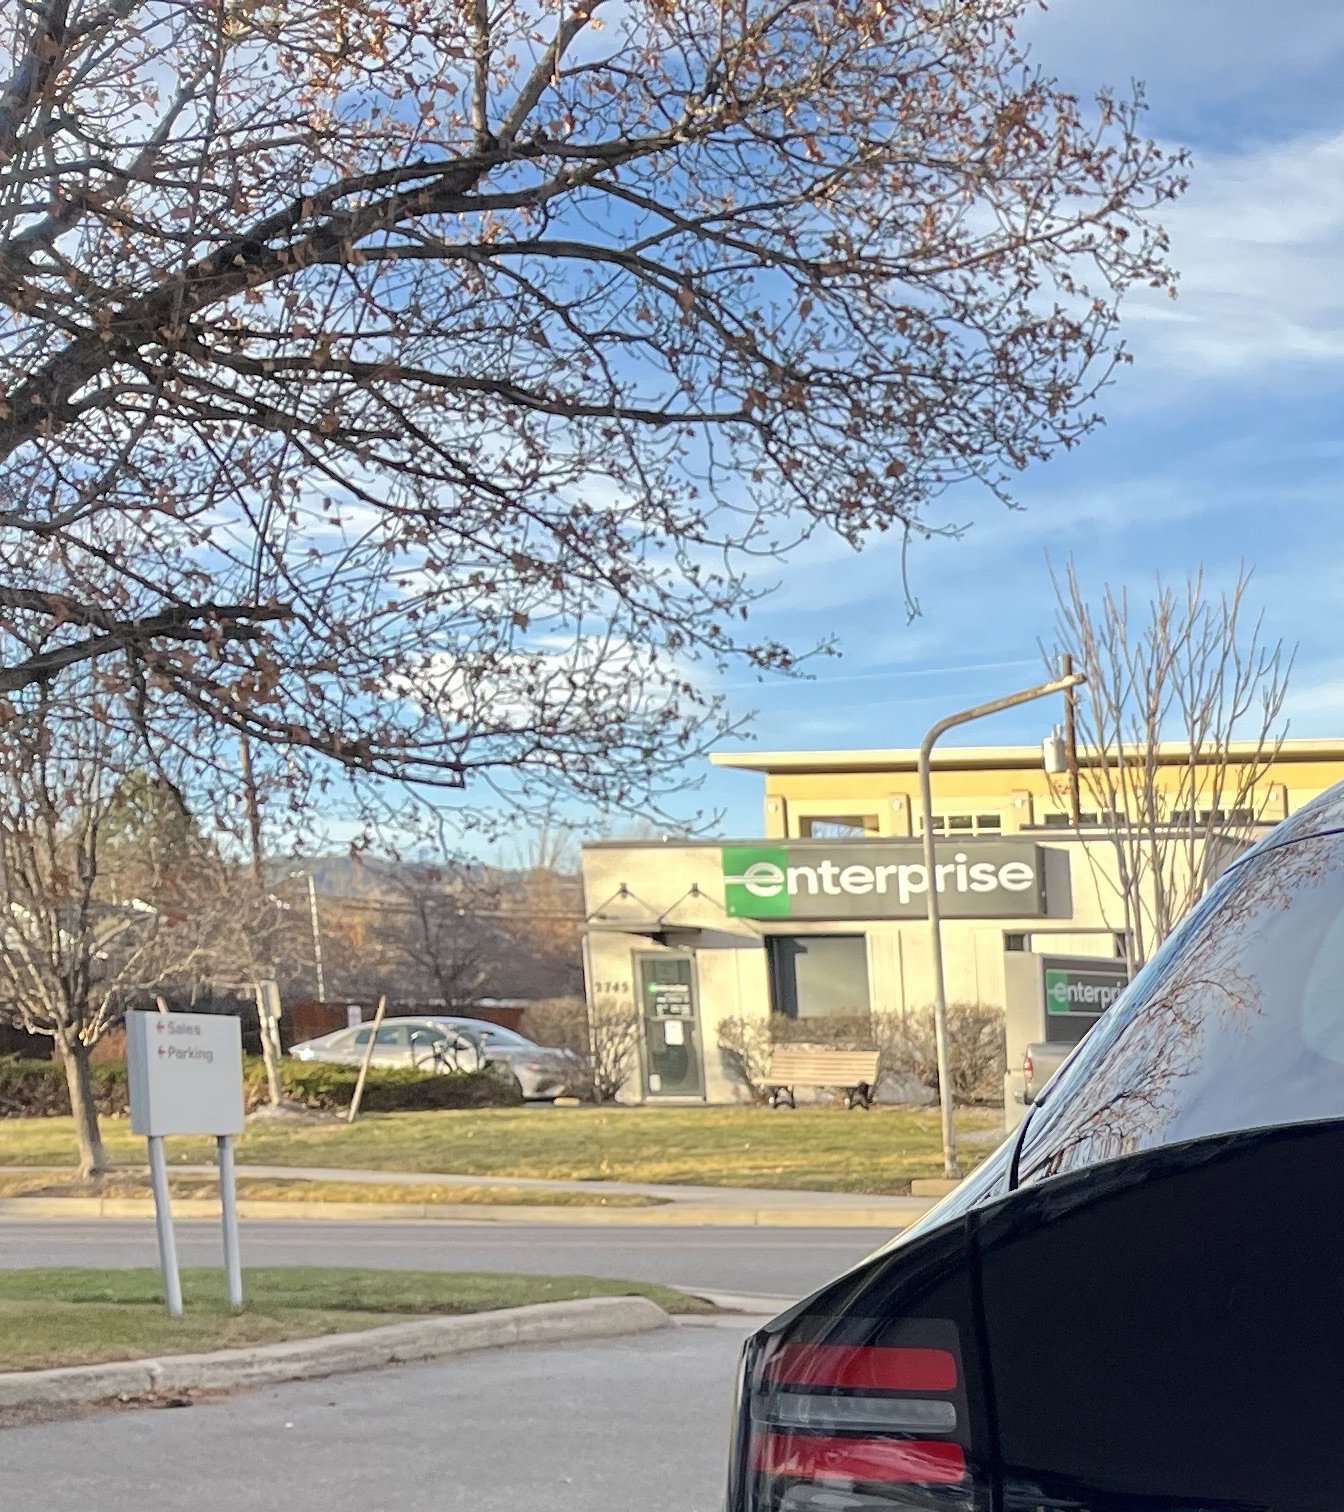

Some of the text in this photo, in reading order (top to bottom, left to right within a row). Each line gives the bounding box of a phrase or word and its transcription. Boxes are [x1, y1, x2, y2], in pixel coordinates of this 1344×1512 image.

[744, 853, 1034, 904] enterprise
[1053, 981, 1126, 1008] enterpri
[167, 1021, 201, 1035] Sales
[167, 1045, 214, 1063] Parking
